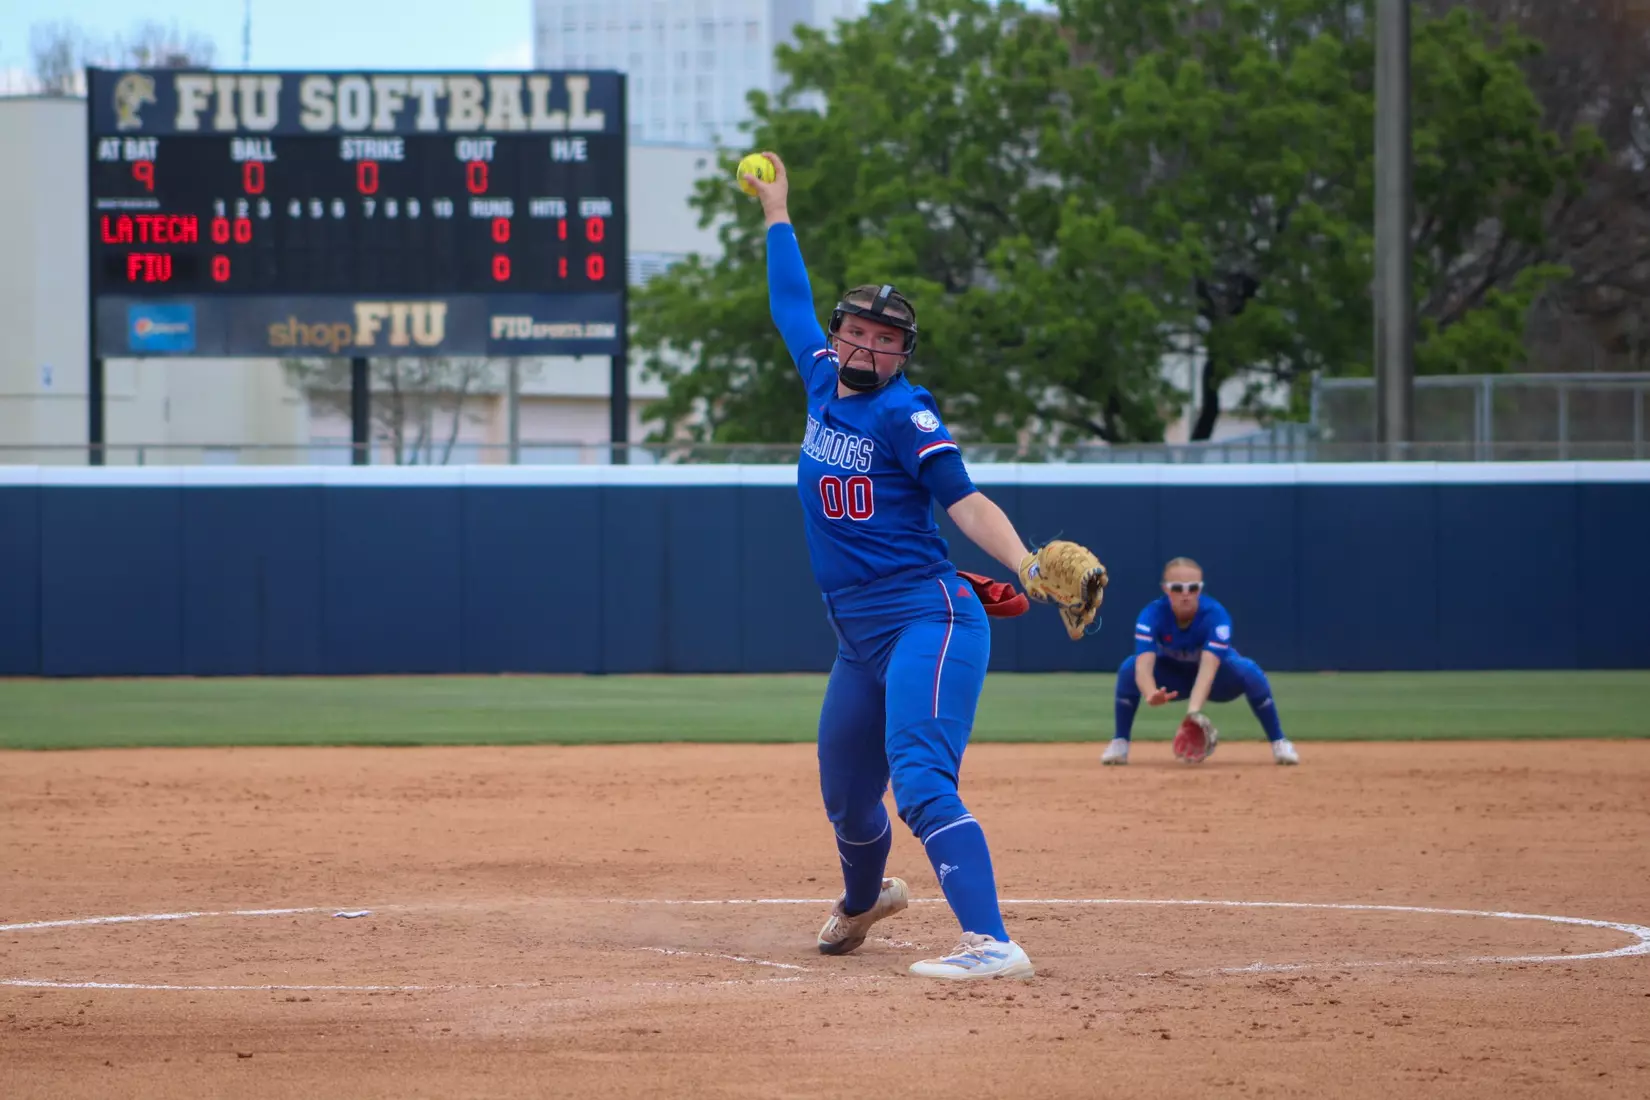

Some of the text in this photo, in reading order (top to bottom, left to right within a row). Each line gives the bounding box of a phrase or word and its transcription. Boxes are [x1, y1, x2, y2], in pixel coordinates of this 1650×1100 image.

[174, 74, 605, 132] FIU SOFTBALL
[98, 138, 158, 161] AT BAT
[230, 138, 276, 161] BALL
[340, 138, 405, 161] STRIKE
[456, 137, 496, 161] OUT
[551, 138, 587, 161] H/E
[132, 160, 155, 192] 9
[242, 160, 265, 194] 0
[356, 160, 379, 194] 0
[466, 160, 489, 194] 0
[470, 198, 514, 218] RUNS
[529, 198, 567, 218] HITS
[579, 198, 612, 218] ERR
[102, 215, 198, 243] LA TECH
[491, 216, 511, 243] 0
[586, 216, 605, 243] 0
[127, 253, 172, 282] FIU
[211, 255, 231, 282] 0
[491, 254, 511, 281] 0
[586, 253, 605, 280] 0
[819, 475, 875, 521] 00
